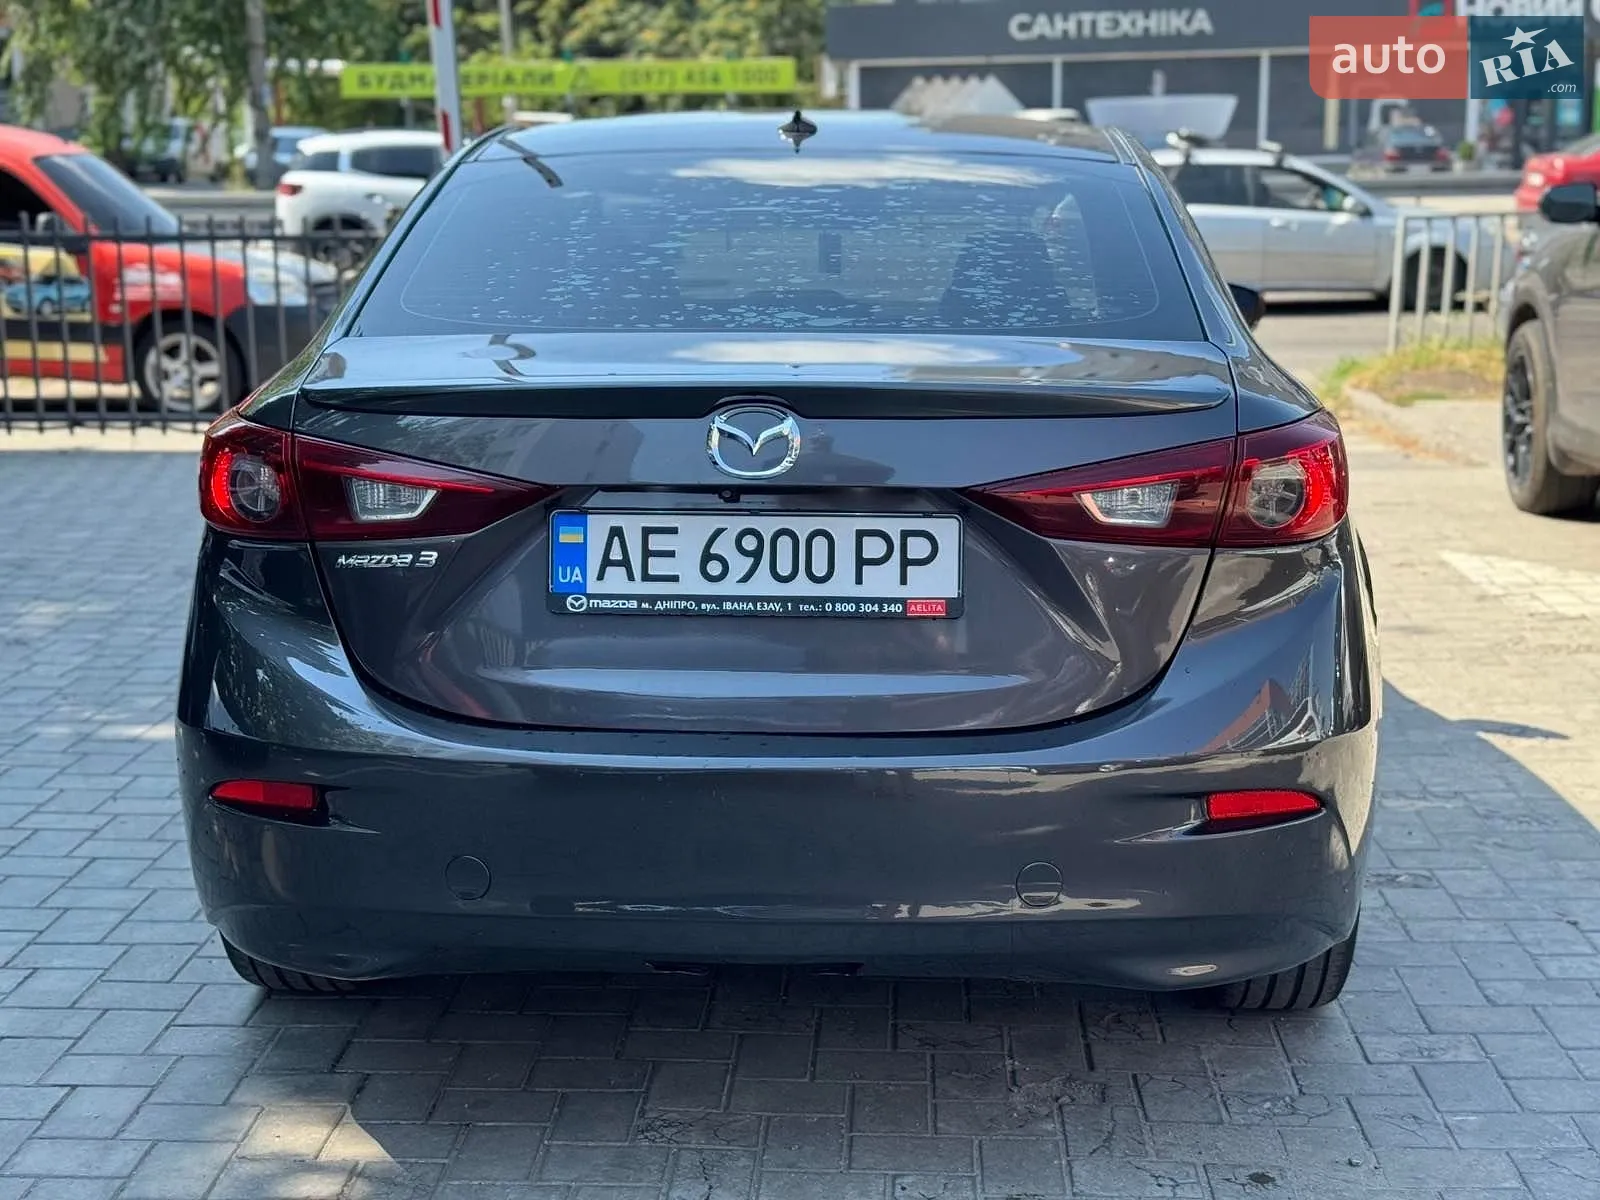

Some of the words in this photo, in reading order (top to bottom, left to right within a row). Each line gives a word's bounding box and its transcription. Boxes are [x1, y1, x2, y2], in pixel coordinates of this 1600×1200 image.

[1008, 8, 1214, 41] САНТЕХНІКА
[415, 551, 438, 567] 3
[596, 525, 680, 583] AE
[699, 527, 836, 585] 6900
[854, 528, 940, 586] PP
[558, 566, 584, 584] UA
[654, 600, 698, 612] ДНІПРО,
[701, 603, 719, 613] вул.
[723, 602, 754, 611] ІВАНА
[787, 603, 792, 611] 1
[799, 603, 822, 612] тел.:
[825, 603, 832, 612] 0
[835, 603, 856, 612] 800
[859, 603, 879, 613] 304
[881, 603, 903, 613] 340
[909, 603, 944, 613] AELITA
